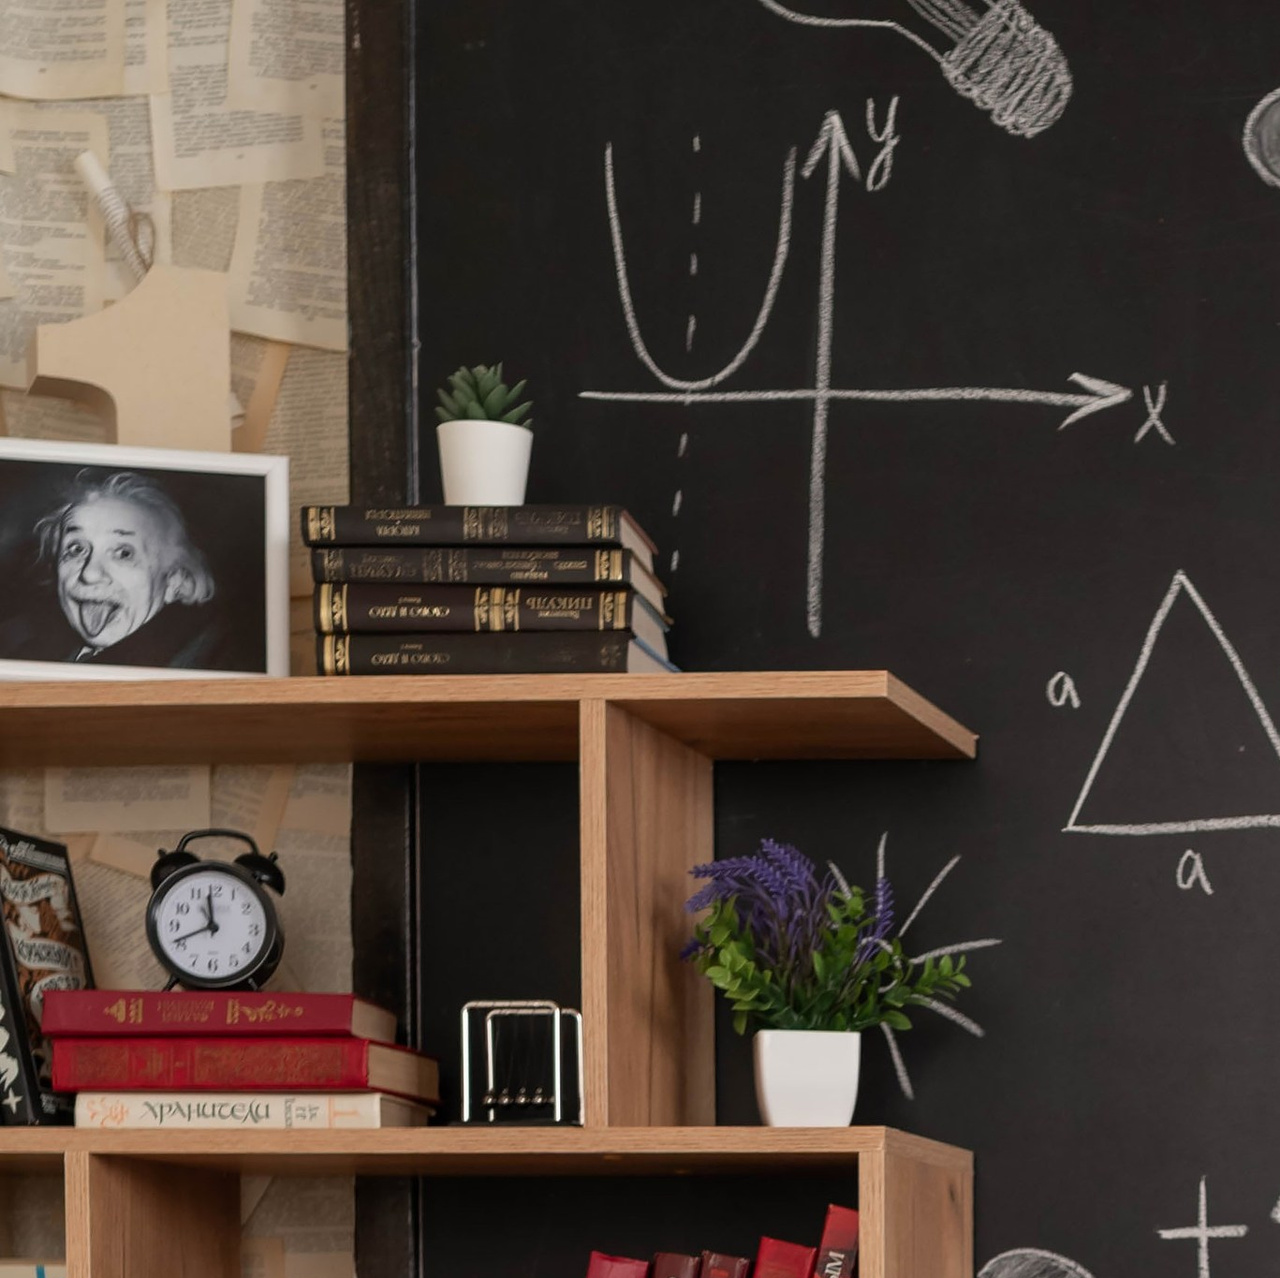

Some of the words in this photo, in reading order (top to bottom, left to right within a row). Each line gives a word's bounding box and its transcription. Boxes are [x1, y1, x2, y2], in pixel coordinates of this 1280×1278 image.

[865, 95, 900, 192] y
[526, 595, 593, 610] ПИКУЛЬ
[1046, 670, 1081, 708] a
[1176, 850, 1213, 895] a
[208, 884, 223, 899] 2
[207, 957, 219, 973] 6
